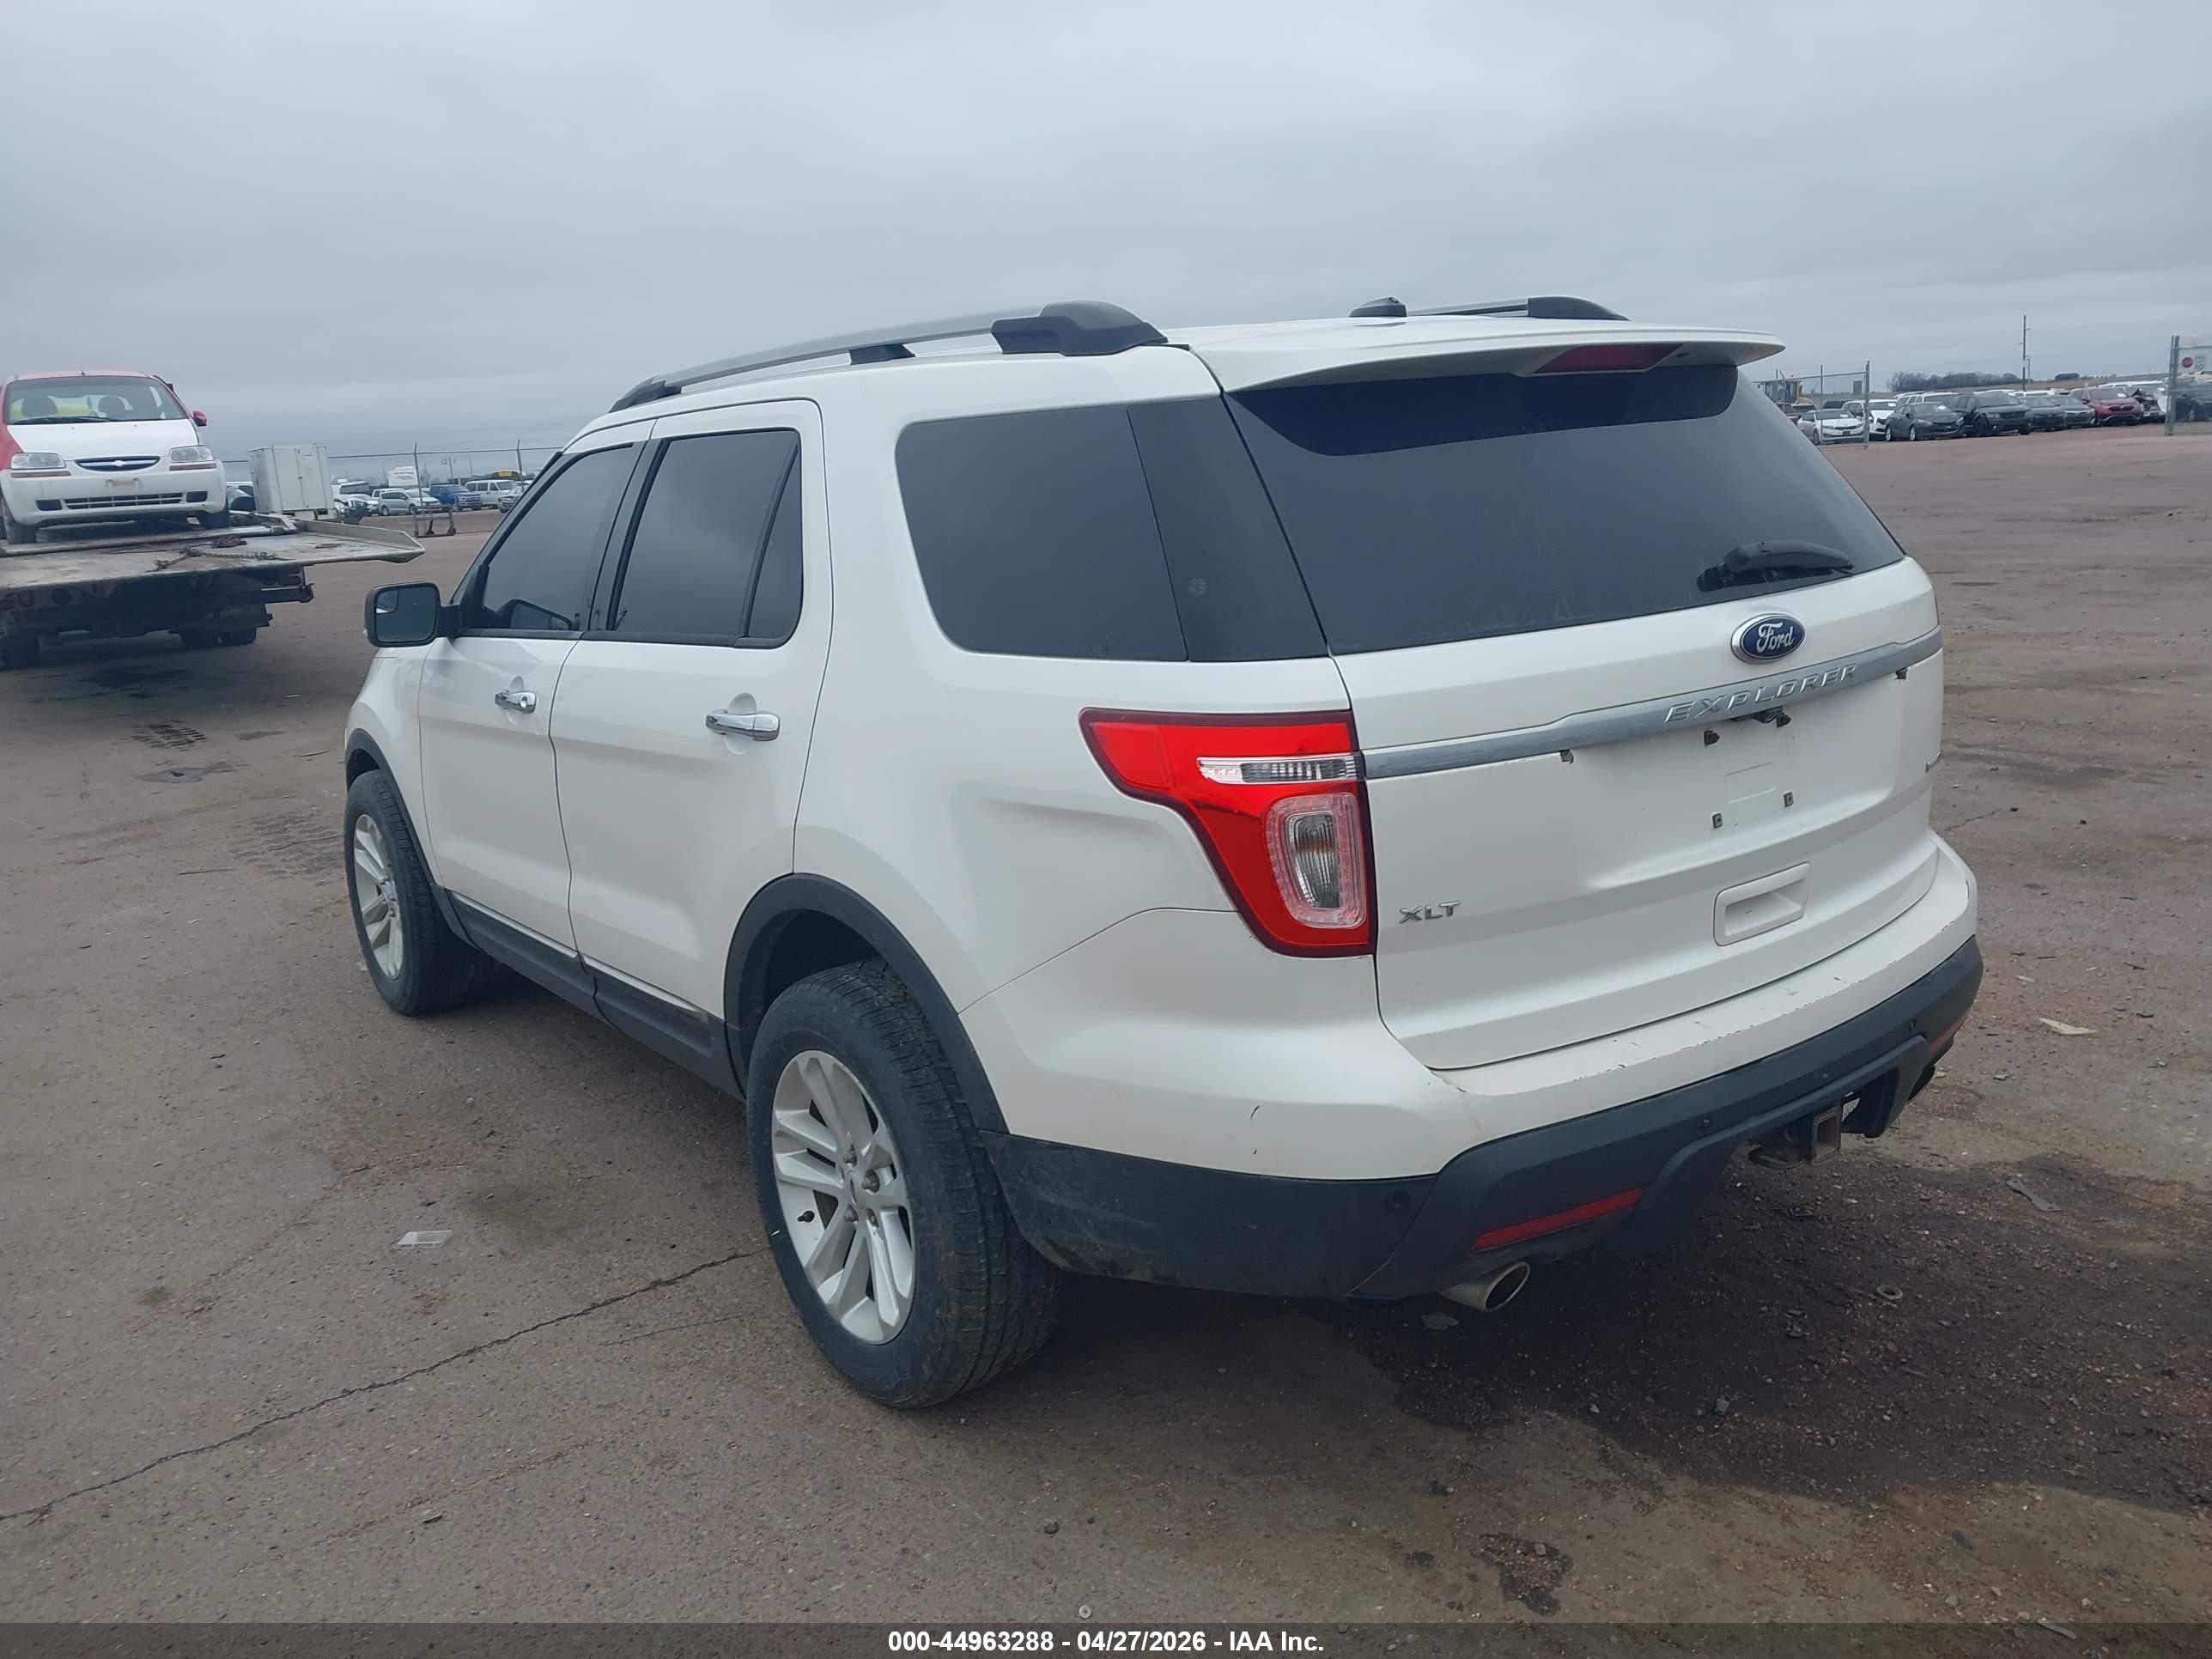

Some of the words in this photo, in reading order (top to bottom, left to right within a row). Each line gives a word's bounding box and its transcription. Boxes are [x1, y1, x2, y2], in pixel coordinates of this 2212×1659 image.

[1756, 621, 1795, 653] Ford
[1663, 663, 1856, 723] EXPLORER
[1399, 901, 1461, 924] XLT
